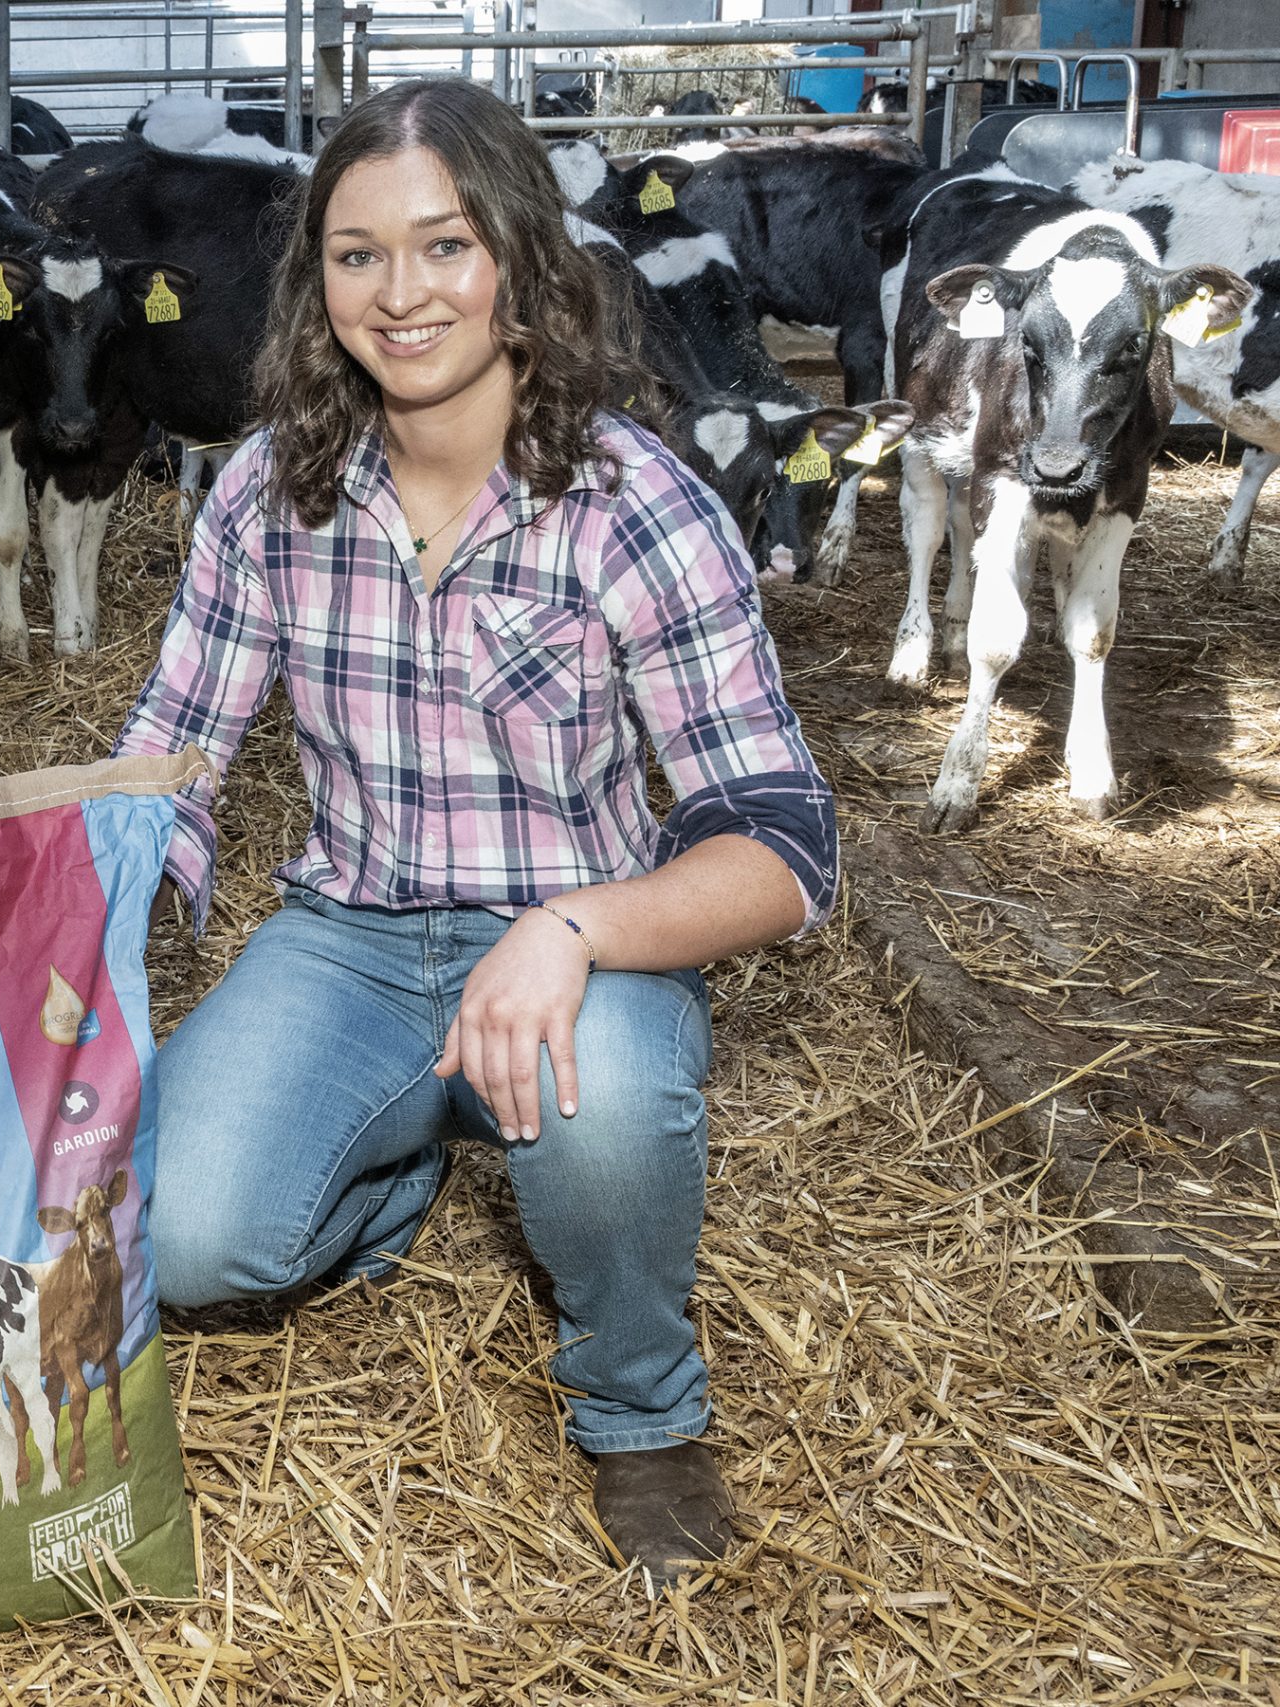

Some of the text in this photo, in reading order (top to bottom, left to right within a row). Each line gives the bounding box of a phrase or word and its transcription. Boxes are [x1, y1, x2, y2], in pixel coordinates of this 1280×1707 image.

[642, 193, 672, 213] 52685
[147, 303, 176, 321] 72687
[792, 461, 827, 481] 92680
[53, 1123, 119, 1156] GARDION
[35, 1490, 127, 1547] FEED FOR
[35, 1511, 130, 1575] GROWTH
